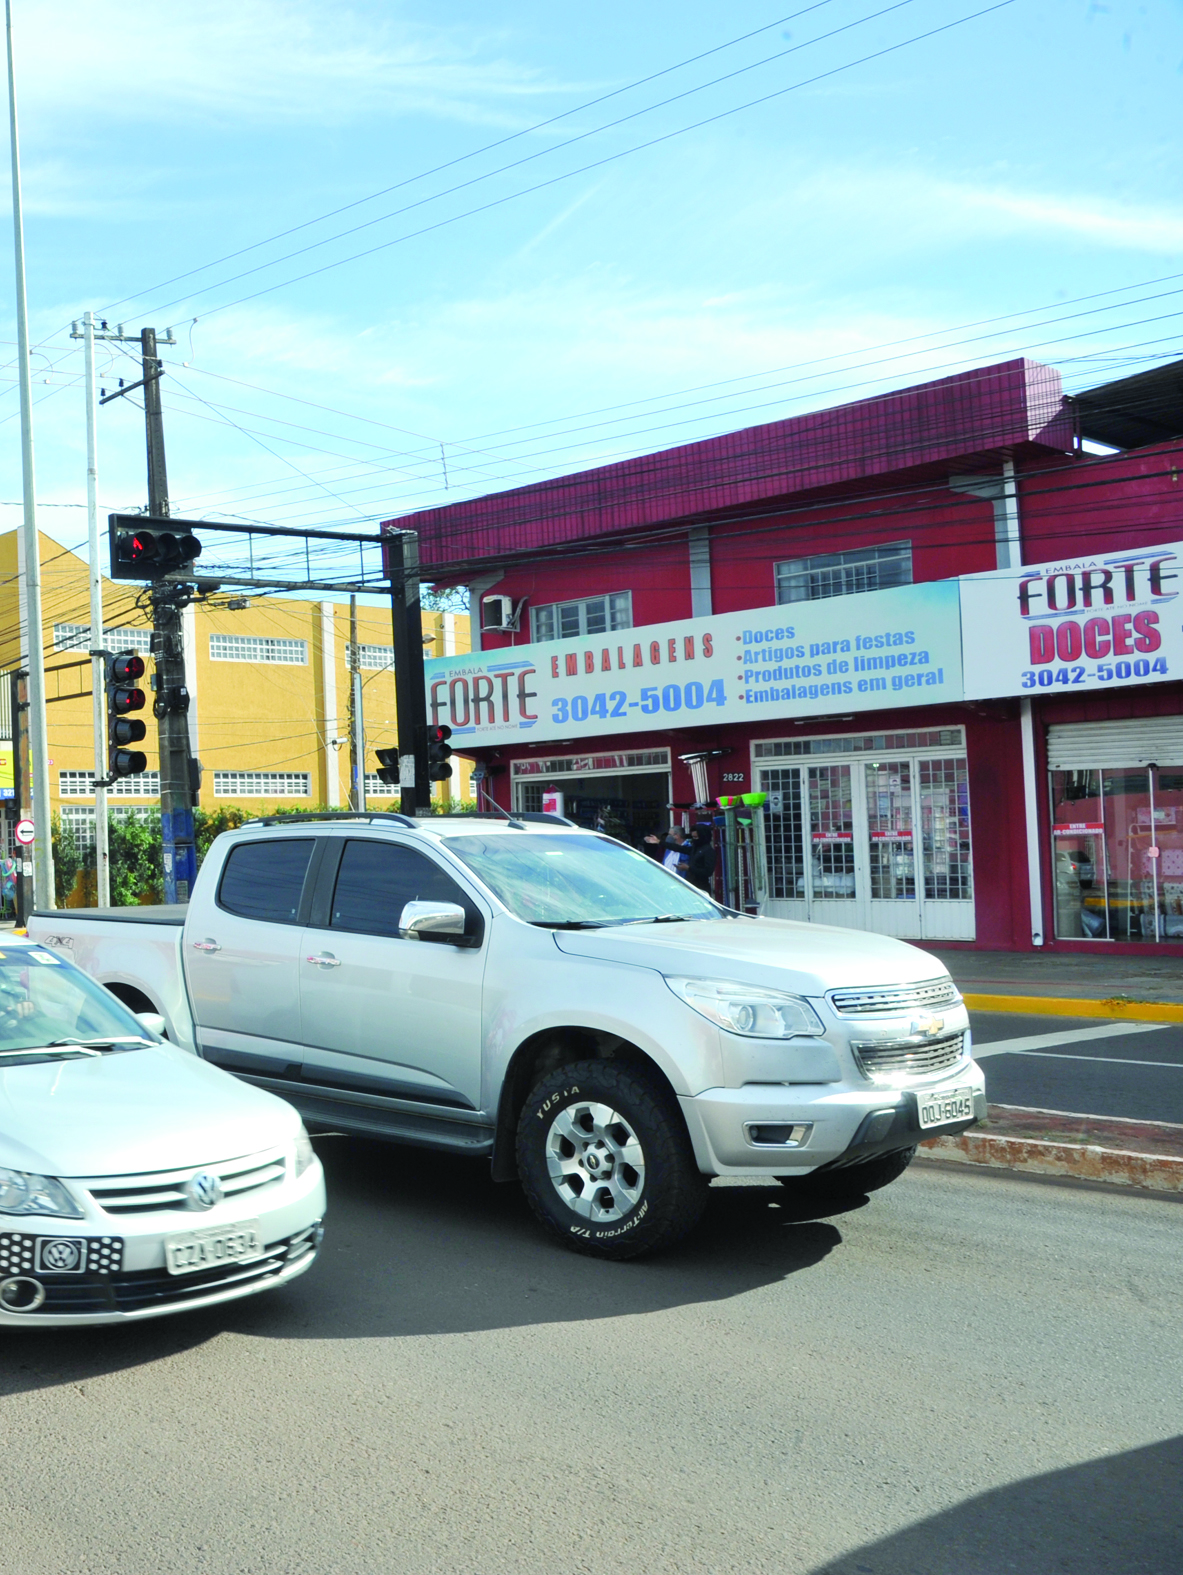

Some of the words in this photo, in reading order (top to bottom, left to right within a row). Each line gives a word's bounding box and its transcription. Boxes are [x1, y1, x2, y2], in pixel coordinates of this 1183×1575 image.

[1045, 561, 1098, 574] EMBALA
[1017, 556, 1180, 616] FORTE
[742, 626, 796, 645] Doces
[743, 645, 805, 665] Artigos
[809, 639, 851, 658] para
[855, 630, 916, 651] festas
[1029, 610, 1162, 665] DOCES
[449, 667, 483, 678] EMBALA
[551, 633, 714, 678] EMBALAGENS
[744, 662, 823, 684] Produtos
[826, 658, 850, 675] de
[853, 650, 930, 672] limpeza
[1021, 656, 1169, 689] 3042-5004
[429, 669, 538, 727] FORTE
[551, 678, 727, 724] 3042-5004
[745, 680, 853, 704] Embalagens
[857, 676, 887, 692] em
[891, 667, 944, 691] geral
[723, 773, 744, 782] 2822
